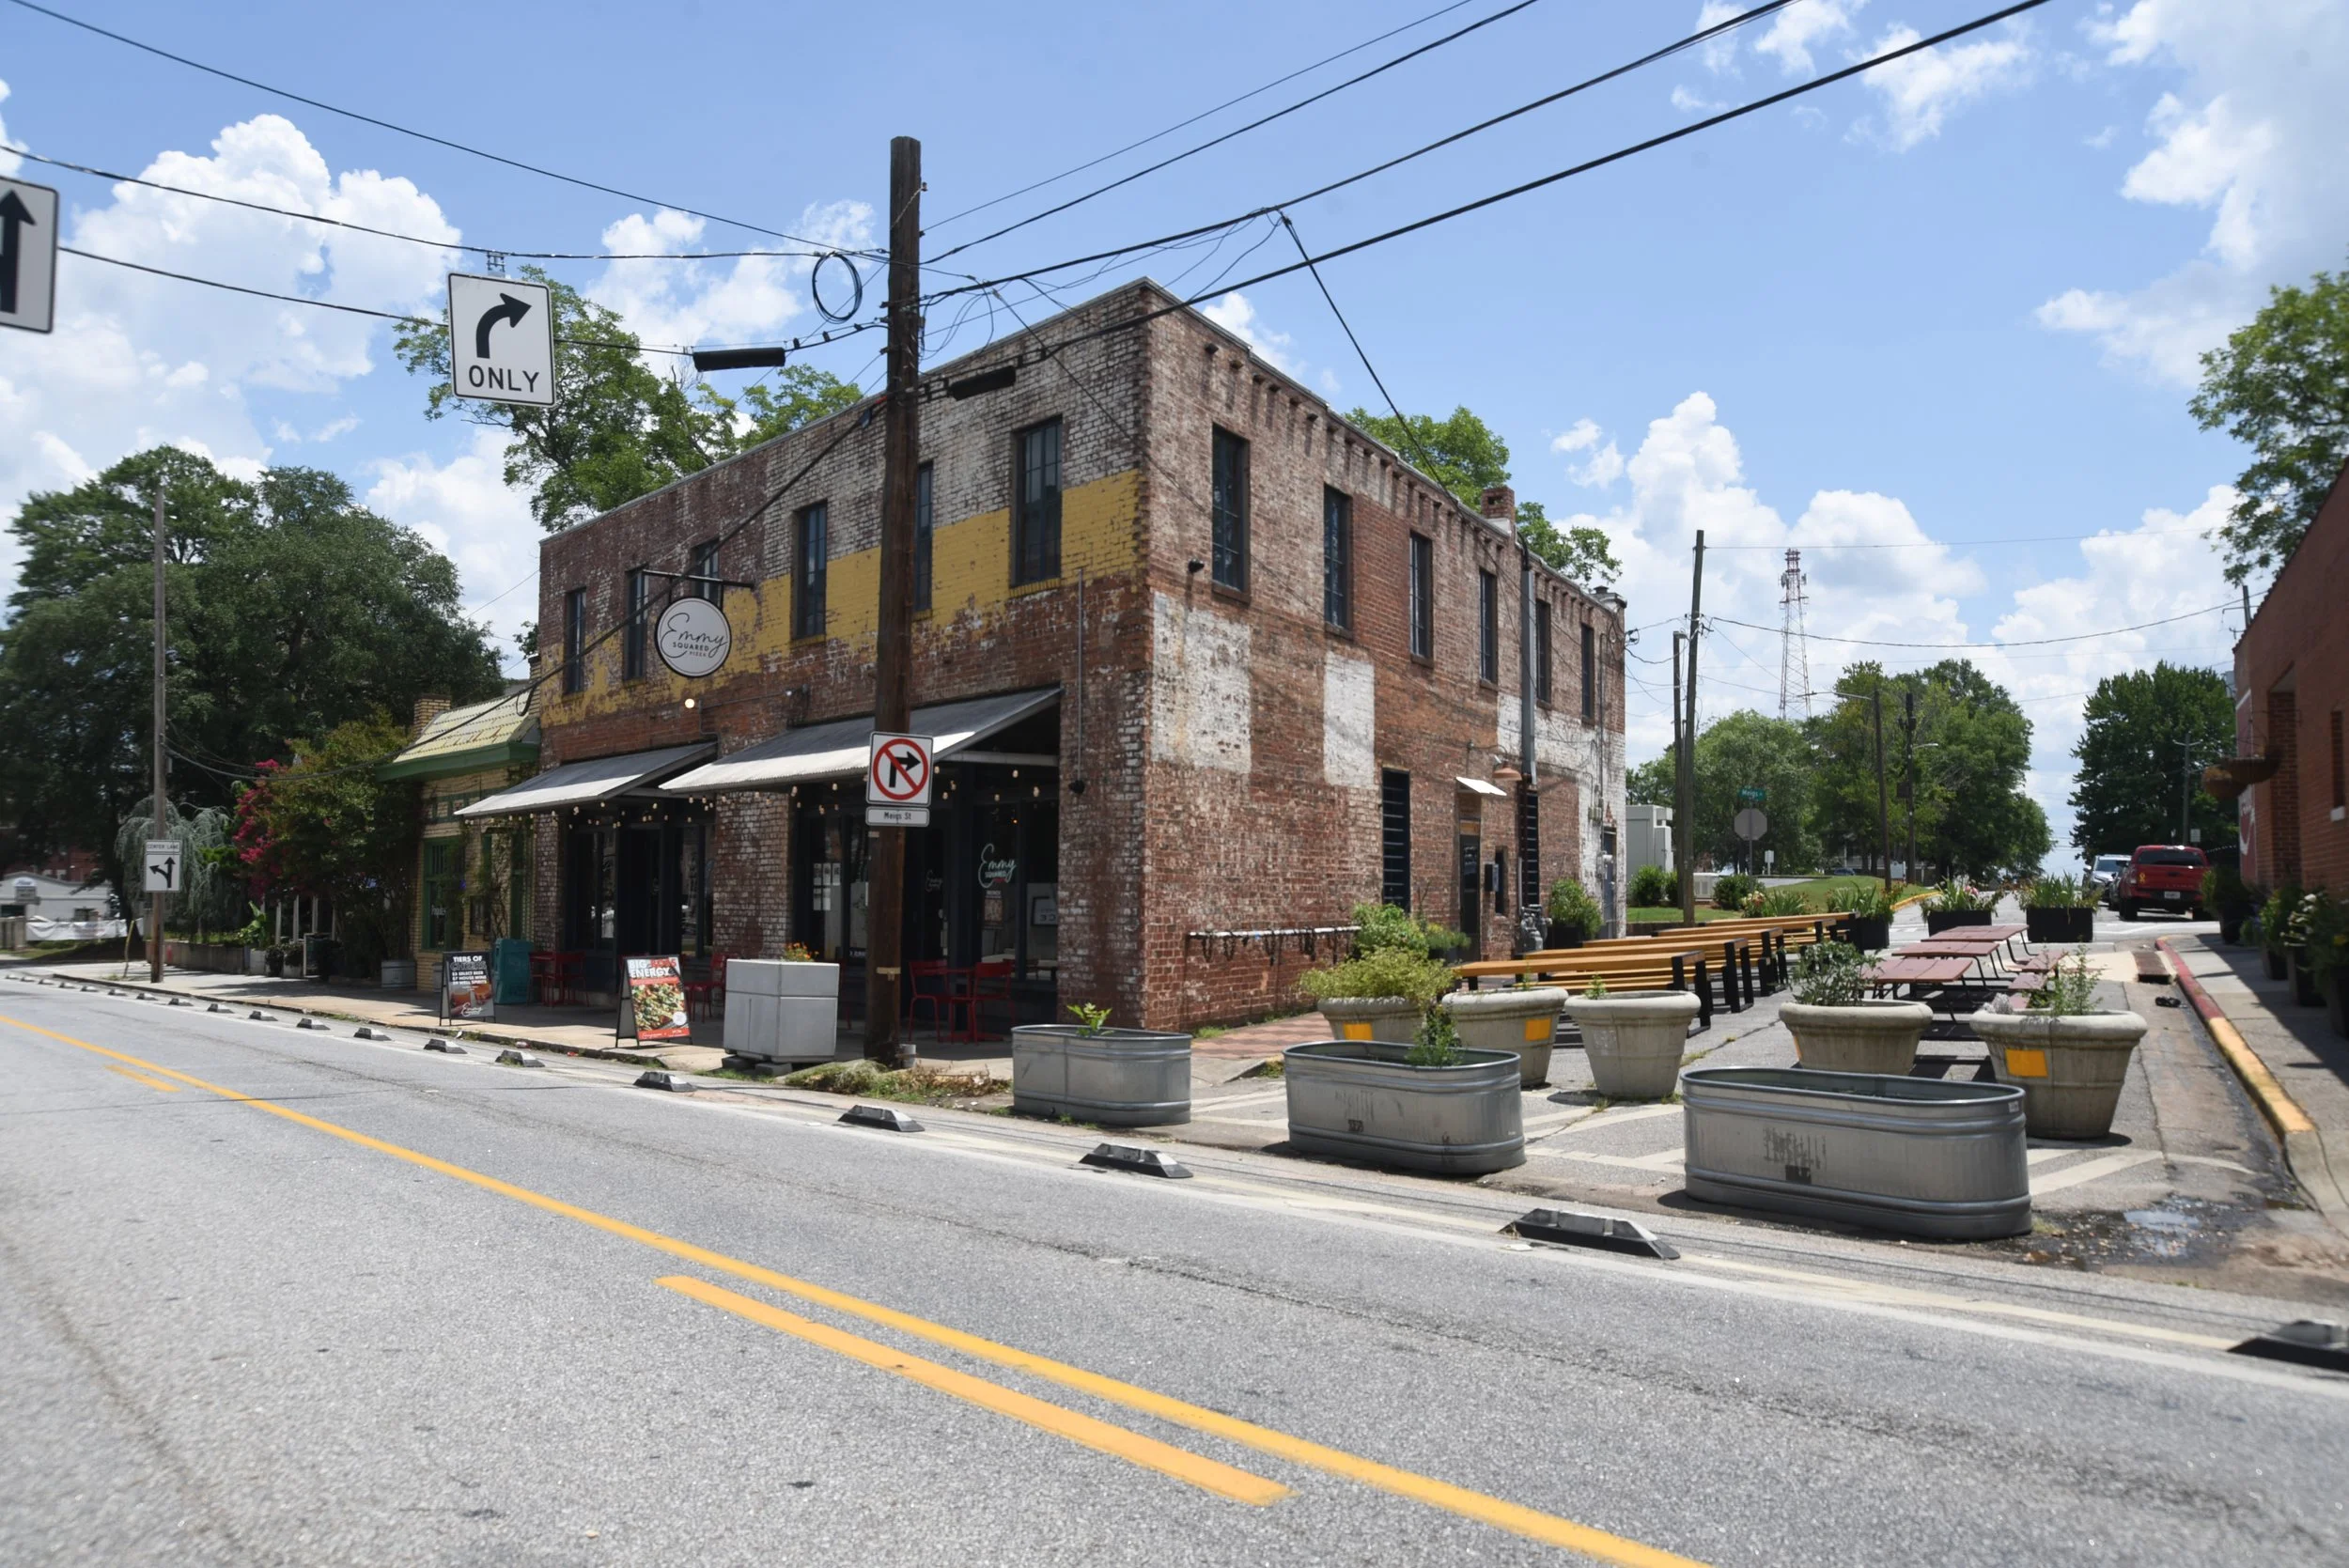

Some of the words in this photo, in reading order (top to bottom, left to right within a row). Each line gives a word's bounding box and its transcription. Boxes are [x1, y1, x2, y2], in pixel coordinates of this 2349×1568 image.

[469, 365, 539, 393] ONLY
[661, 613, 728, 658] Emmy
[673, 642, 709, 651] SQUARED
[883, 811, 902, 820] Meigs
[905, 812, 911, 820] St
[978, 843, 1017, 888] Emmy
[628, 959, 646, 969] BIG
[630, 967, 670, 978] ENERGY
